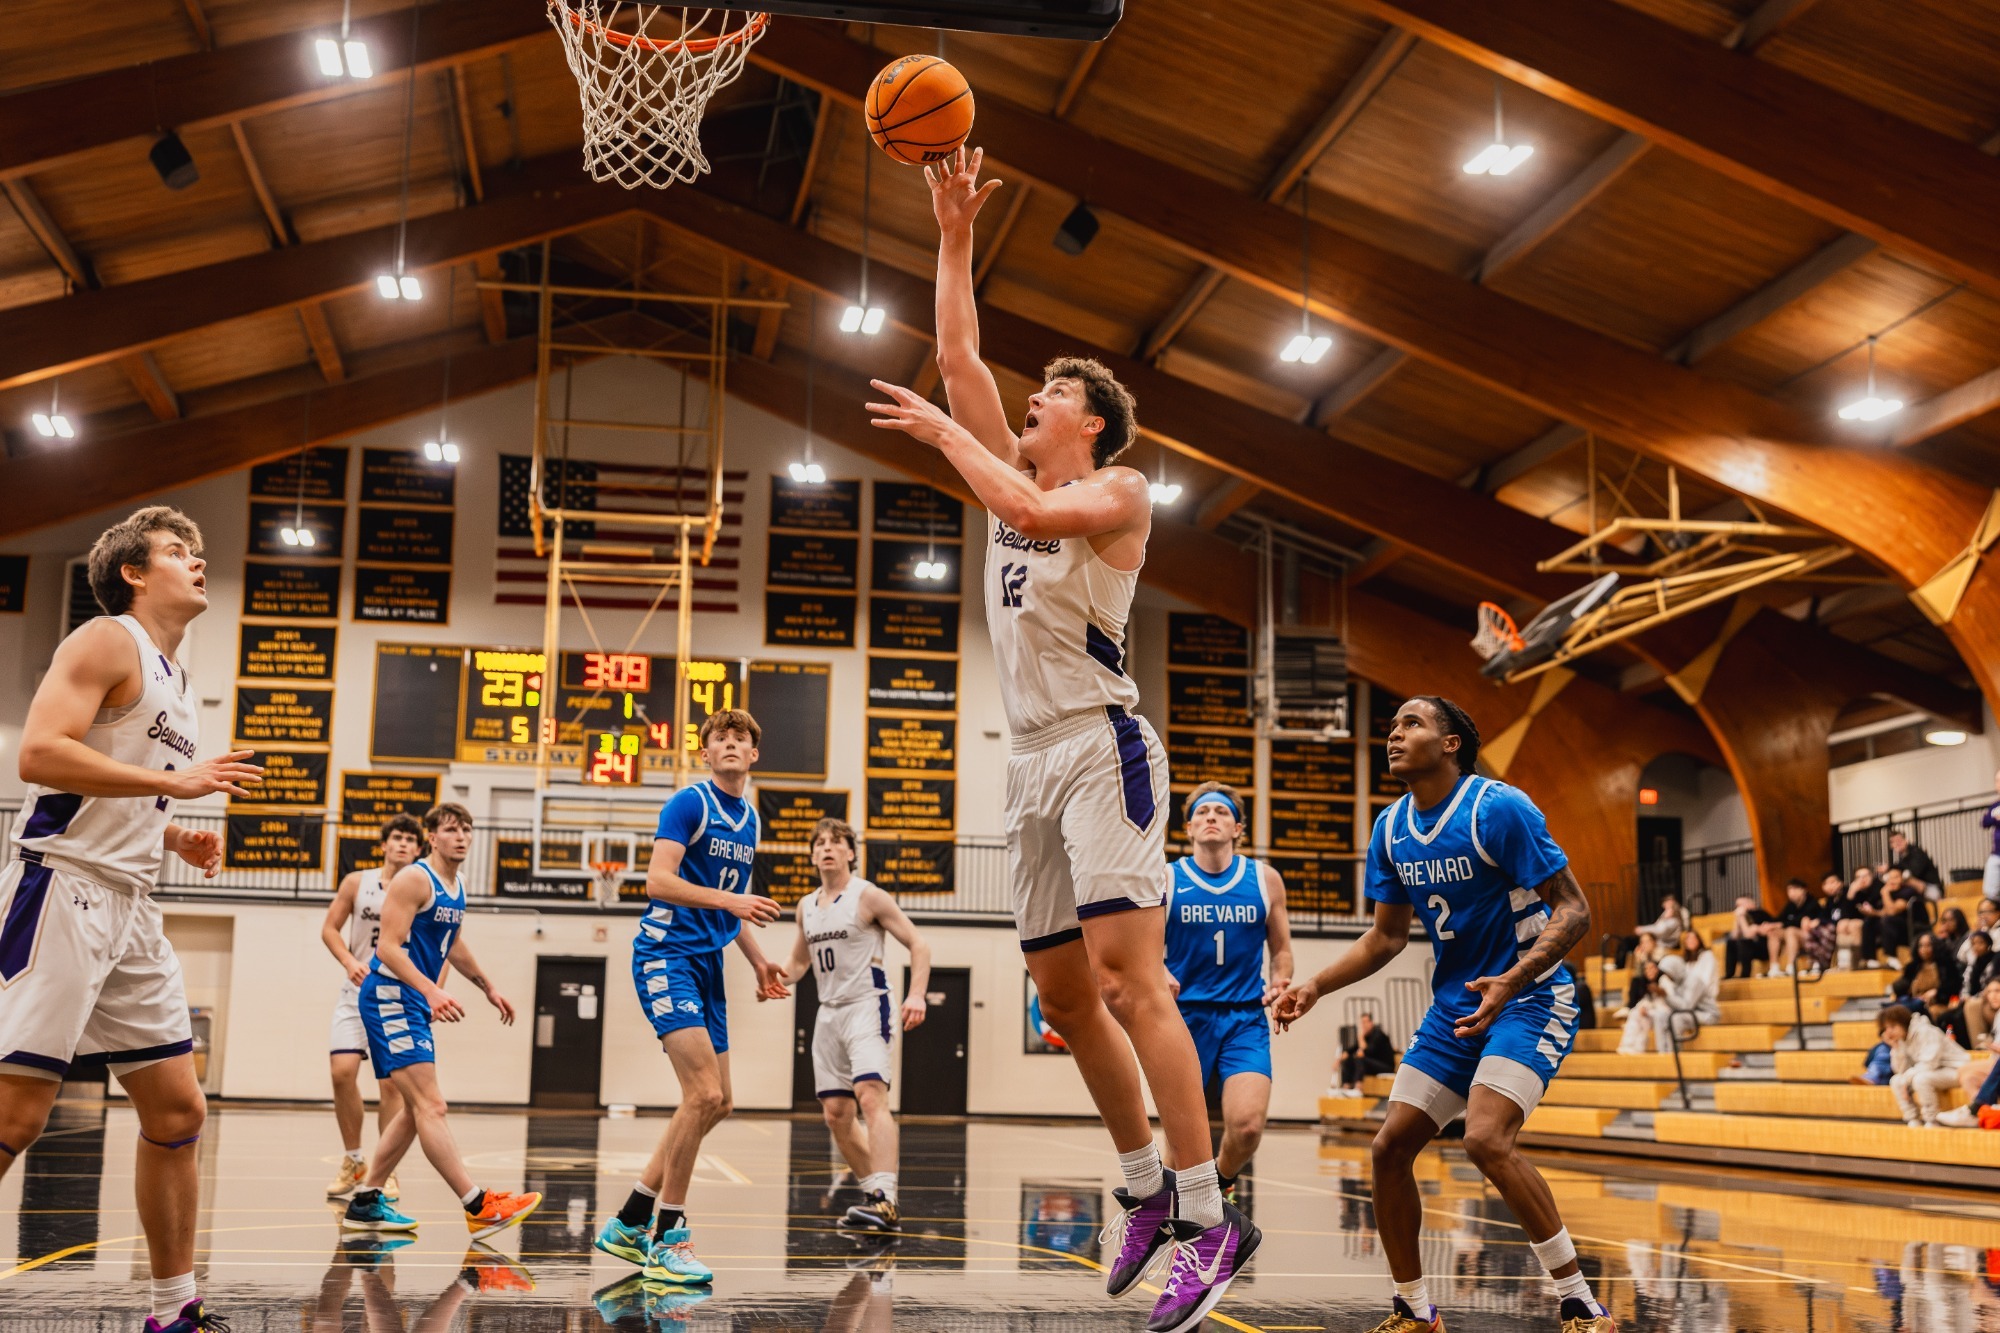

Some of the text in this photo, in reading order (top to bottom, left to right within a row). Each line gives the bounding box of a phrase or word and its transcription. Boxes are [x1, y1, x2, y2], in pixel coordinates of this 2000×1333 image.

[1001, 562, 1028, 607] 12
[583, 653, 650, 690] 3:09
[482, 671, 524, 707] 23
[692, 682, 736, 717] 41
[511, 715, 530, 744] 5
[651, 722, 670, 750] 4
[592, 751, 635, 788] 24
[708, 836, 756, 865] BREVARD
[717, 866, 740, 892] 12
[1395, 855, 1475, 886] BREVARD
[1180, 904, 1259, 924] BREVARD
[1427, 894, 1456, 941] 2
[817, 947, 835, 973] 10
[1213, 929, 1225, 967] 1
